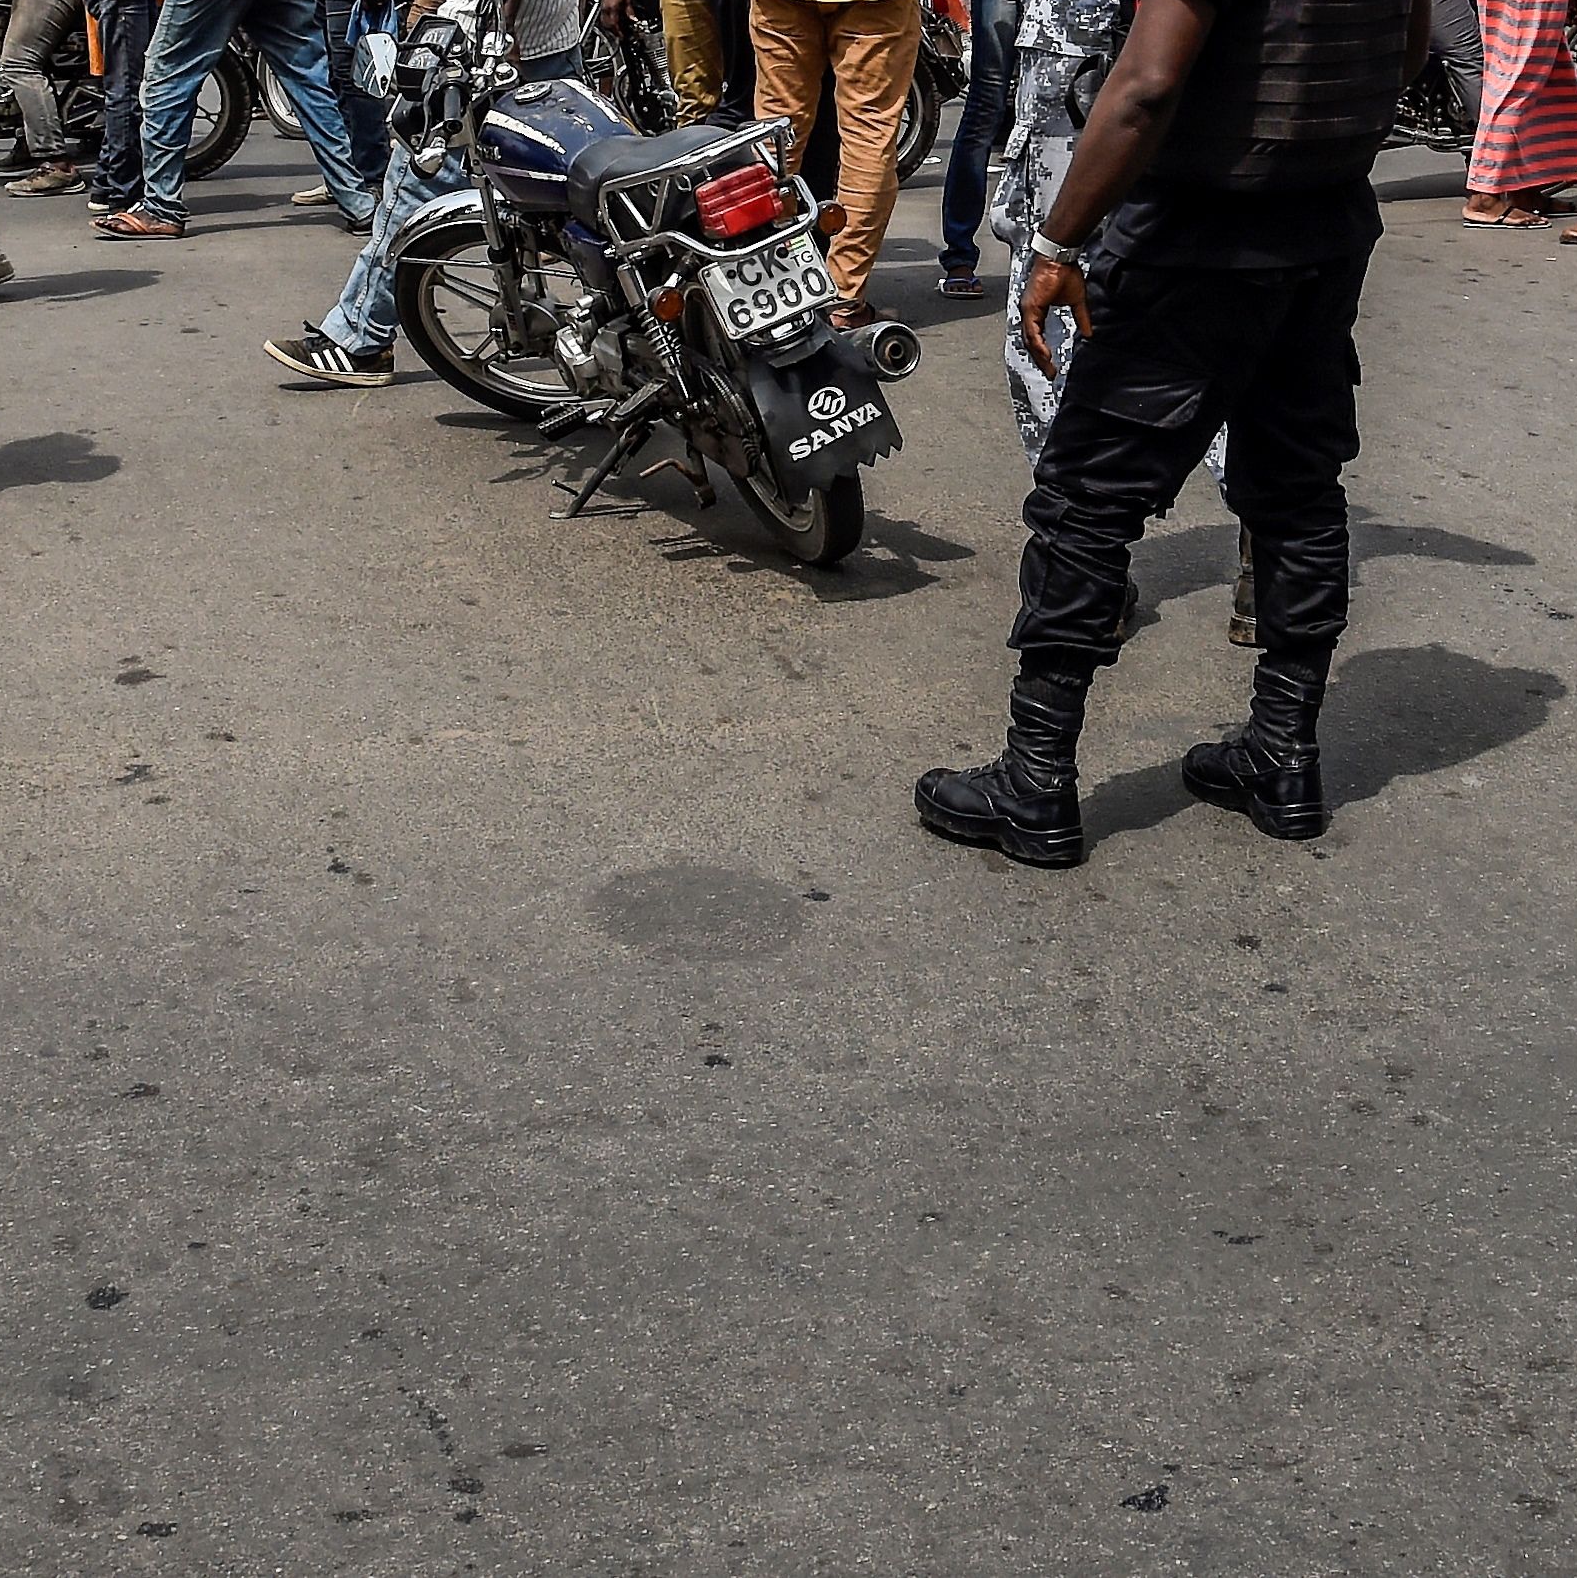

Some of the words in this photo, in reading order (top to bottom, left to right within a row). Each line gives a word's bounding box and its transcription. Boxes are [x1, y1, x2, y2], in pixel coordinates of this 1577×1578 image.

[736, 248, 790, 287] CK
[790, 250, 814, 268] TG
[727, 267, 827, 329] 6900
